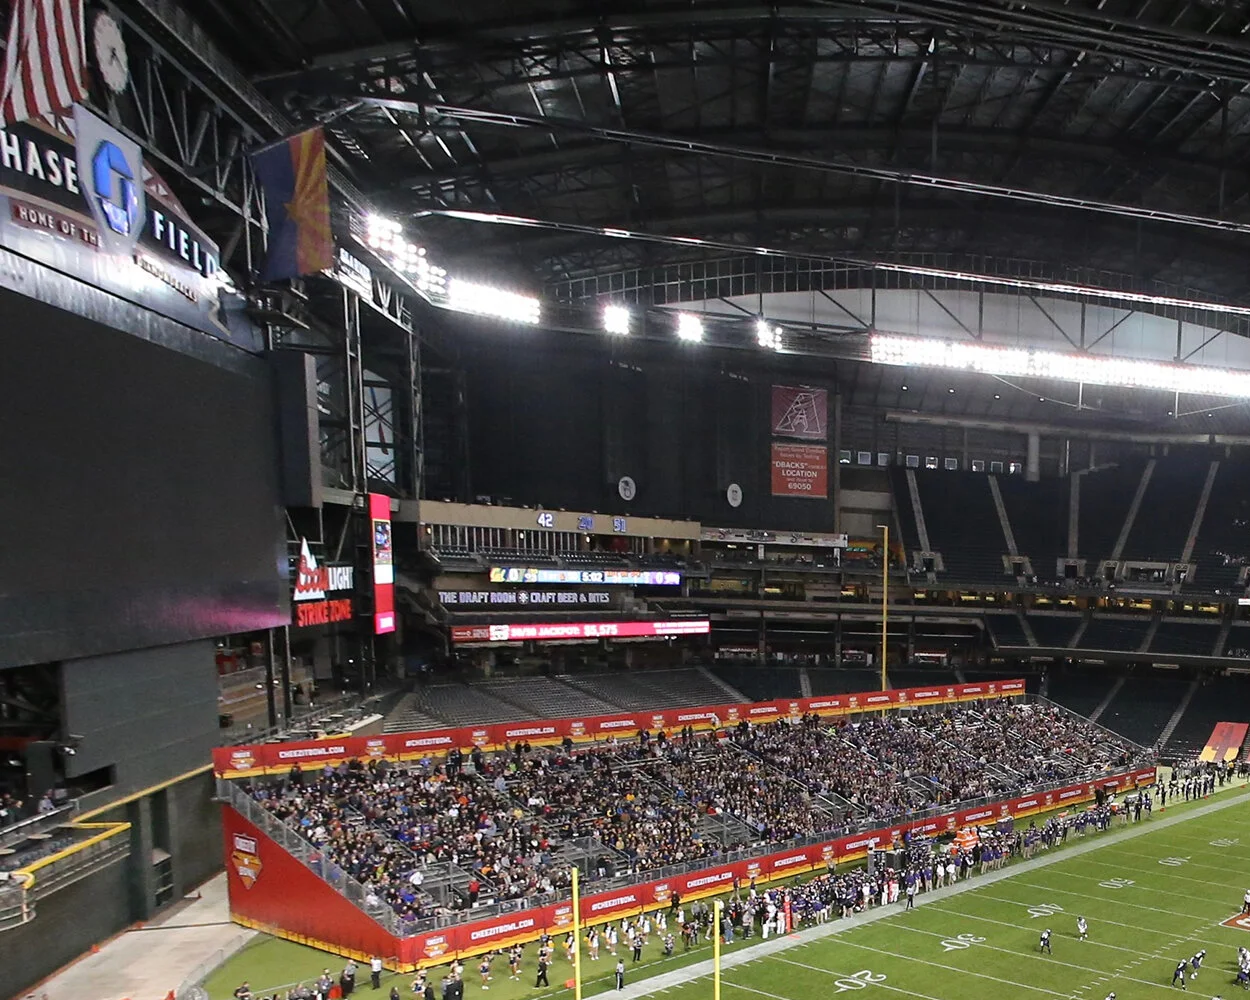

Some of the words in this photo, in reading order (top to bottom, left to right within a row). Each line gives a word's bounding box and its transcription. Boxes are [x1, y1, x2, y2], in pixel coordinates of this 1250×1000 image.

[19, 206, 54, 229] HOME
[61, 220, 76, 236] OF
[82, 228, 102, 247] THE
[153, 210, 216, 279] FIELD
[782, 469, 817, 478] LOCATION
[537, 513, 553, 528] 42
[578, 516, 593, 530] 20
[614, 518, 627, 533] 51
[328, 566, 353, 591] LIGHT
[439, 591, 457, 603] THE
[459, 591, 489, 604] DRAFT
[490, 591, 516, 603] ROOM
[530, 592, 556, 603] CRAFT
[558, 592, 578, 603] BEER
[588, 592, 610, 603] BITES
[297, 600, 328, 627] STRIKE
[330, 598, 352, 620] ZONE
[279, 746, 344, 759] CHEEZITBOWL.COM
[592, 894, 637, 911] #CHEEZITBOWL
[471, 918, 535, 940] CHEEZITBOWL.COM
[941, 933, 986, 950] 30
[834, 969, 887, 990] 20
